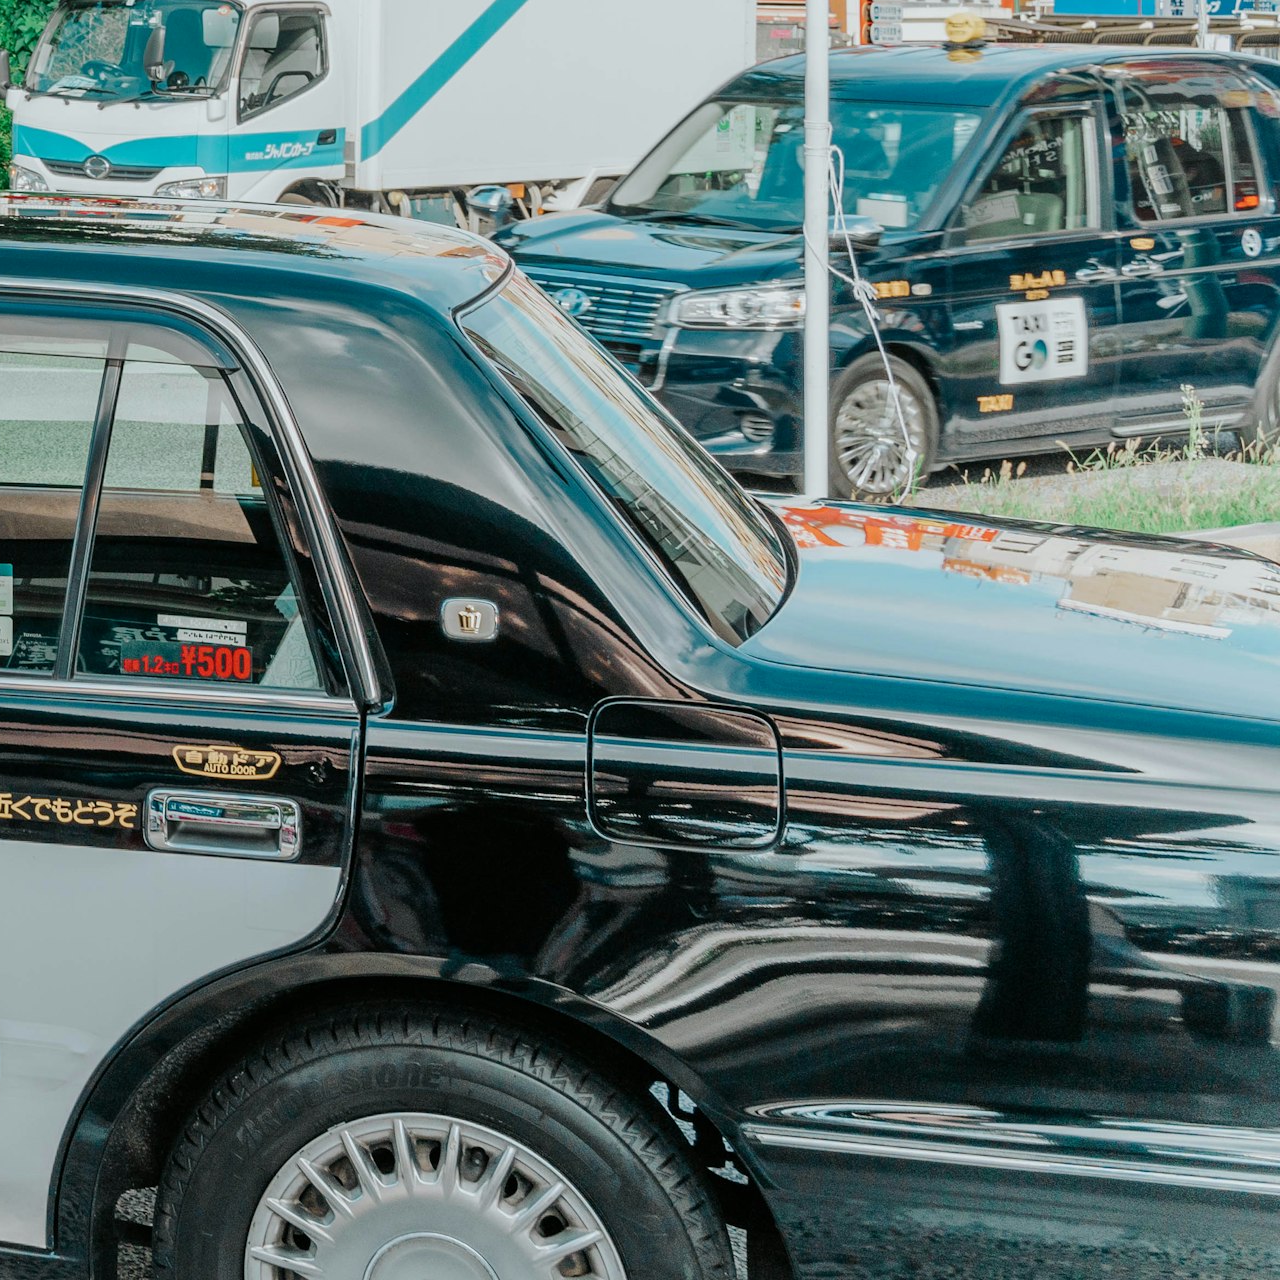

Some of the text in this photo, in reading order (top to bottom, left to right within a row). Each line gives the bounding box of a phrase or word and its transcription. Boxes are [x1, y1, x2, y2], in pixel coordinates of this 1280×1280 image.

[181, 644, 252, 680] ¥500
[185, 750, 276, 769] 自動ドア
[203, 761, 256, 777] AUTO DOOR
